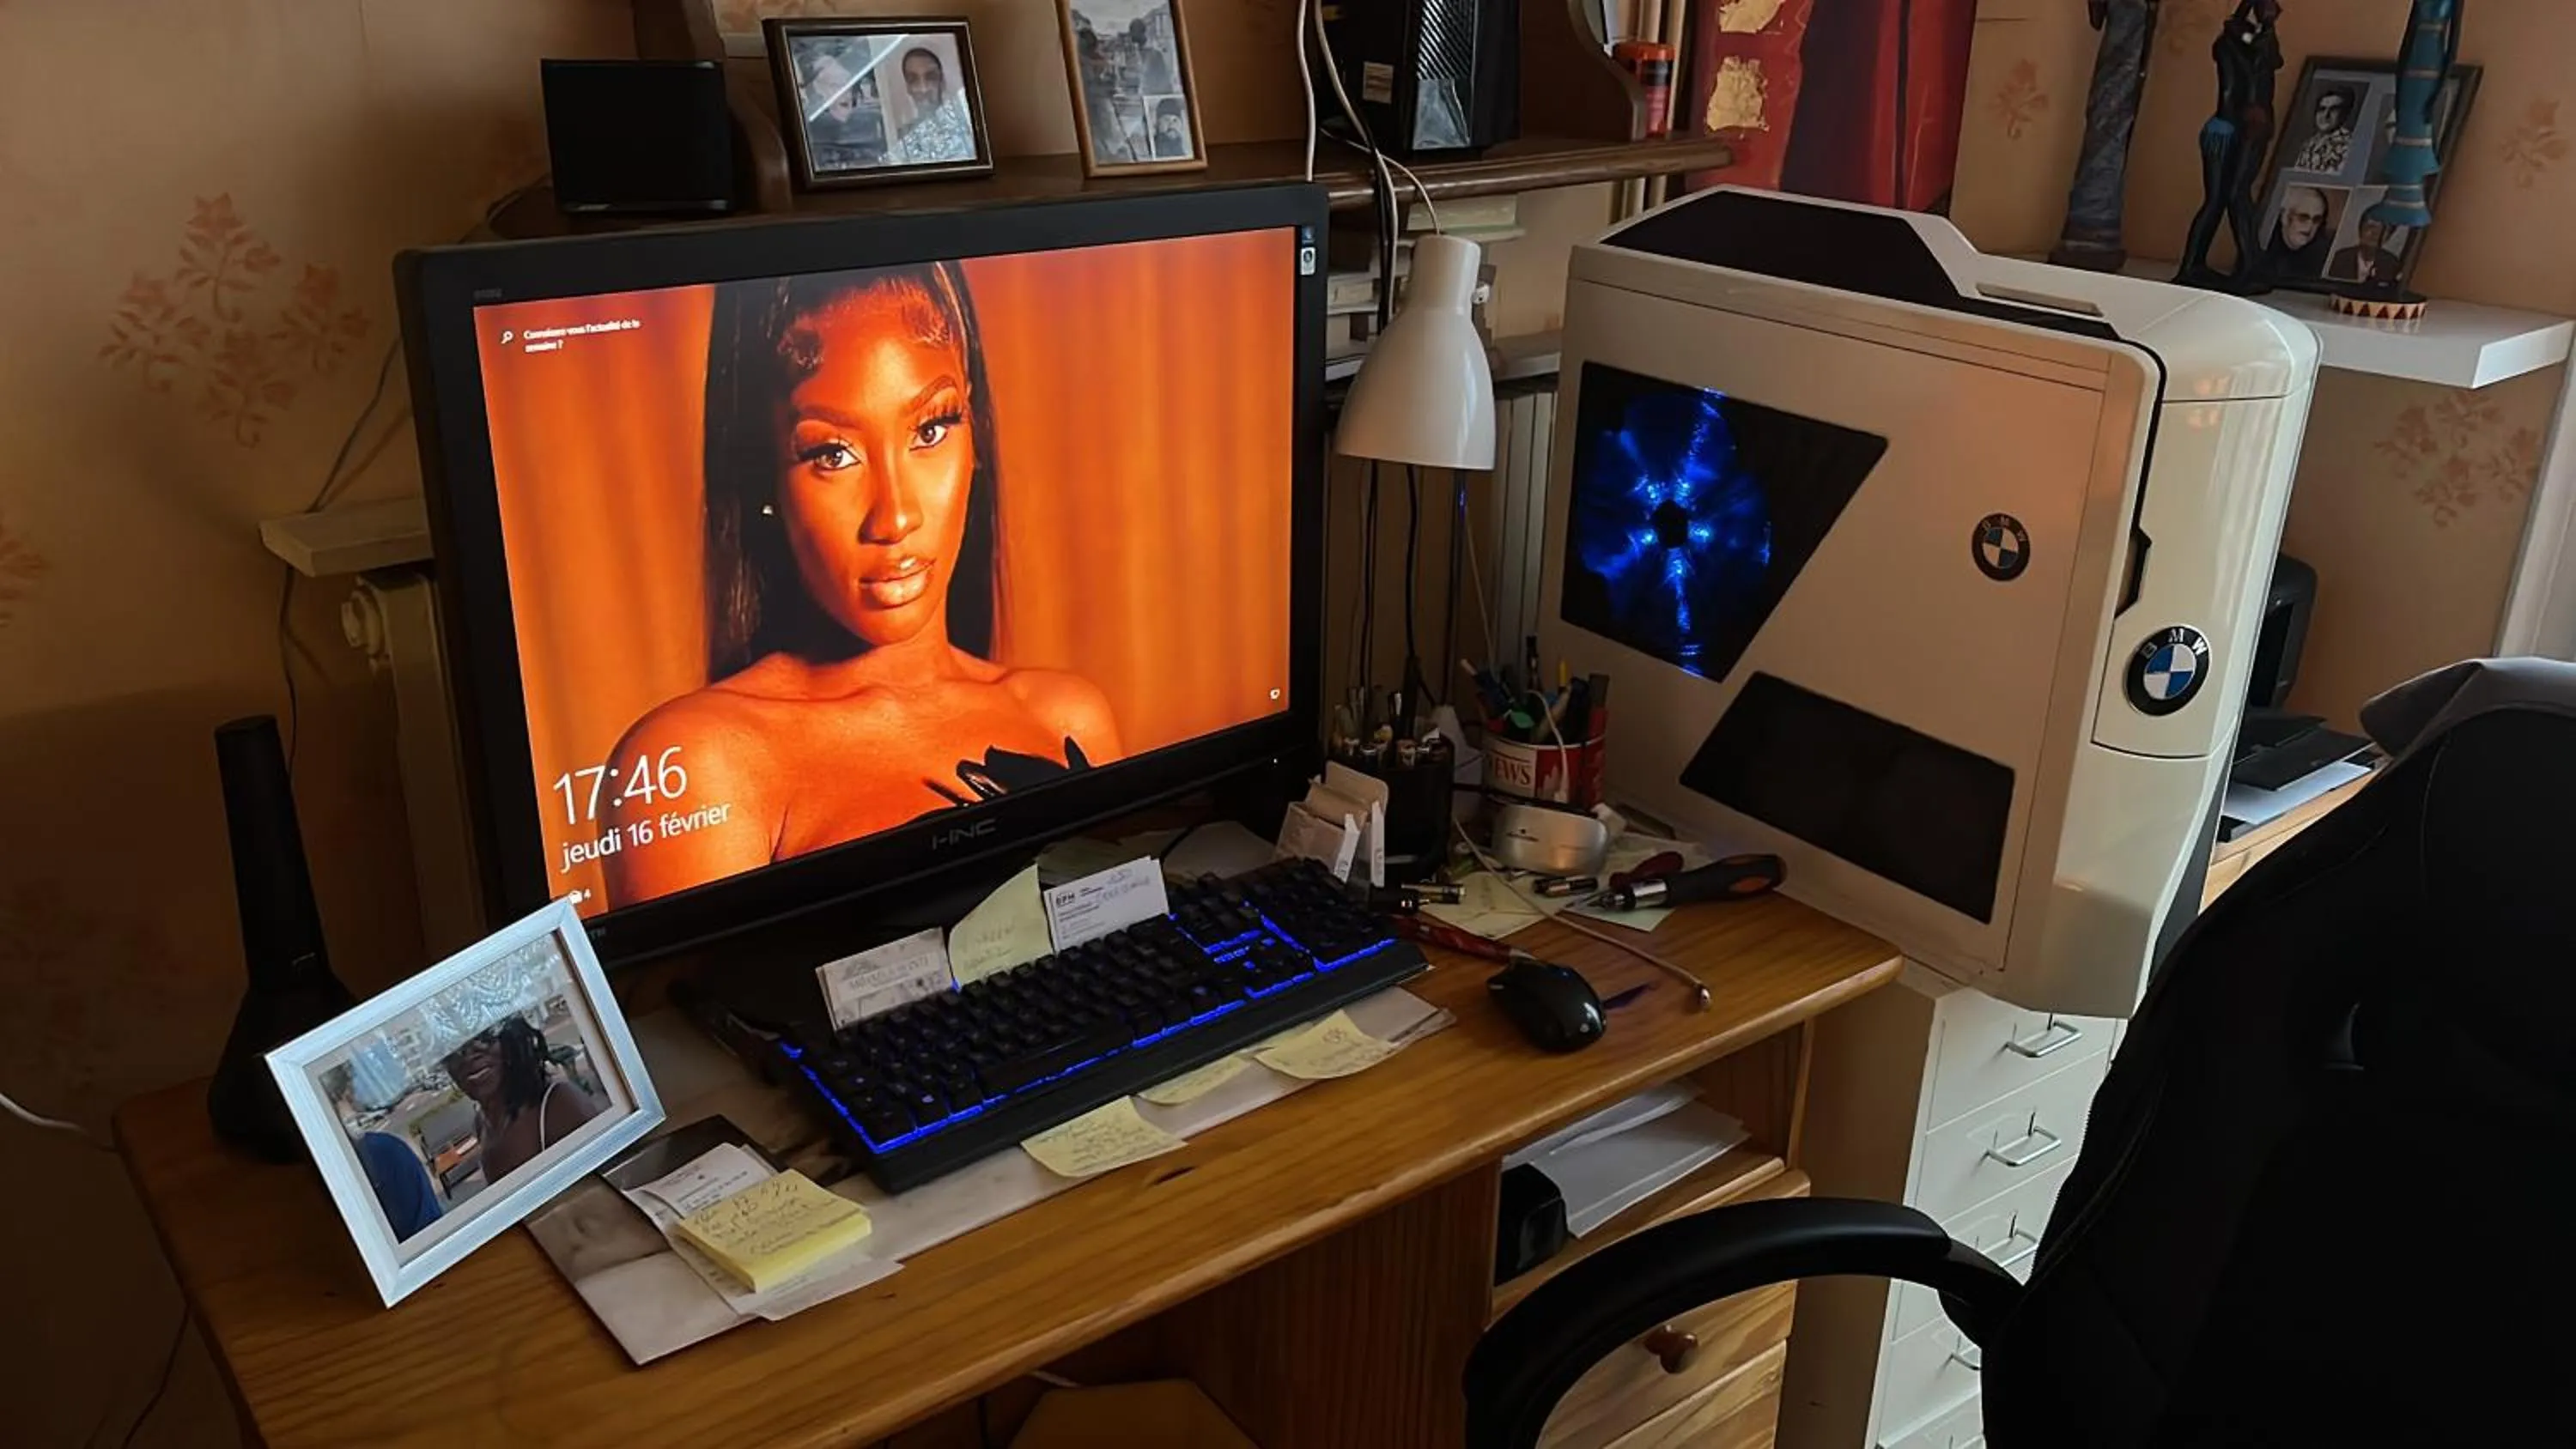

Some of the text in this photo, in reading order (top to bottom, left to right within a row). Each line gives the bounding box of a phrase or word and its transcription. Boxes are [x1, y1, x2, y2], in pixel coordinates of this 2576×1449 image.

[1982, 515, 2026, 542] BMW
[2141, 627, 2208, 659] BMW
[553, 746, 687, 825] 17:46
[560, 803, 732, 874] jeudi 16 février
